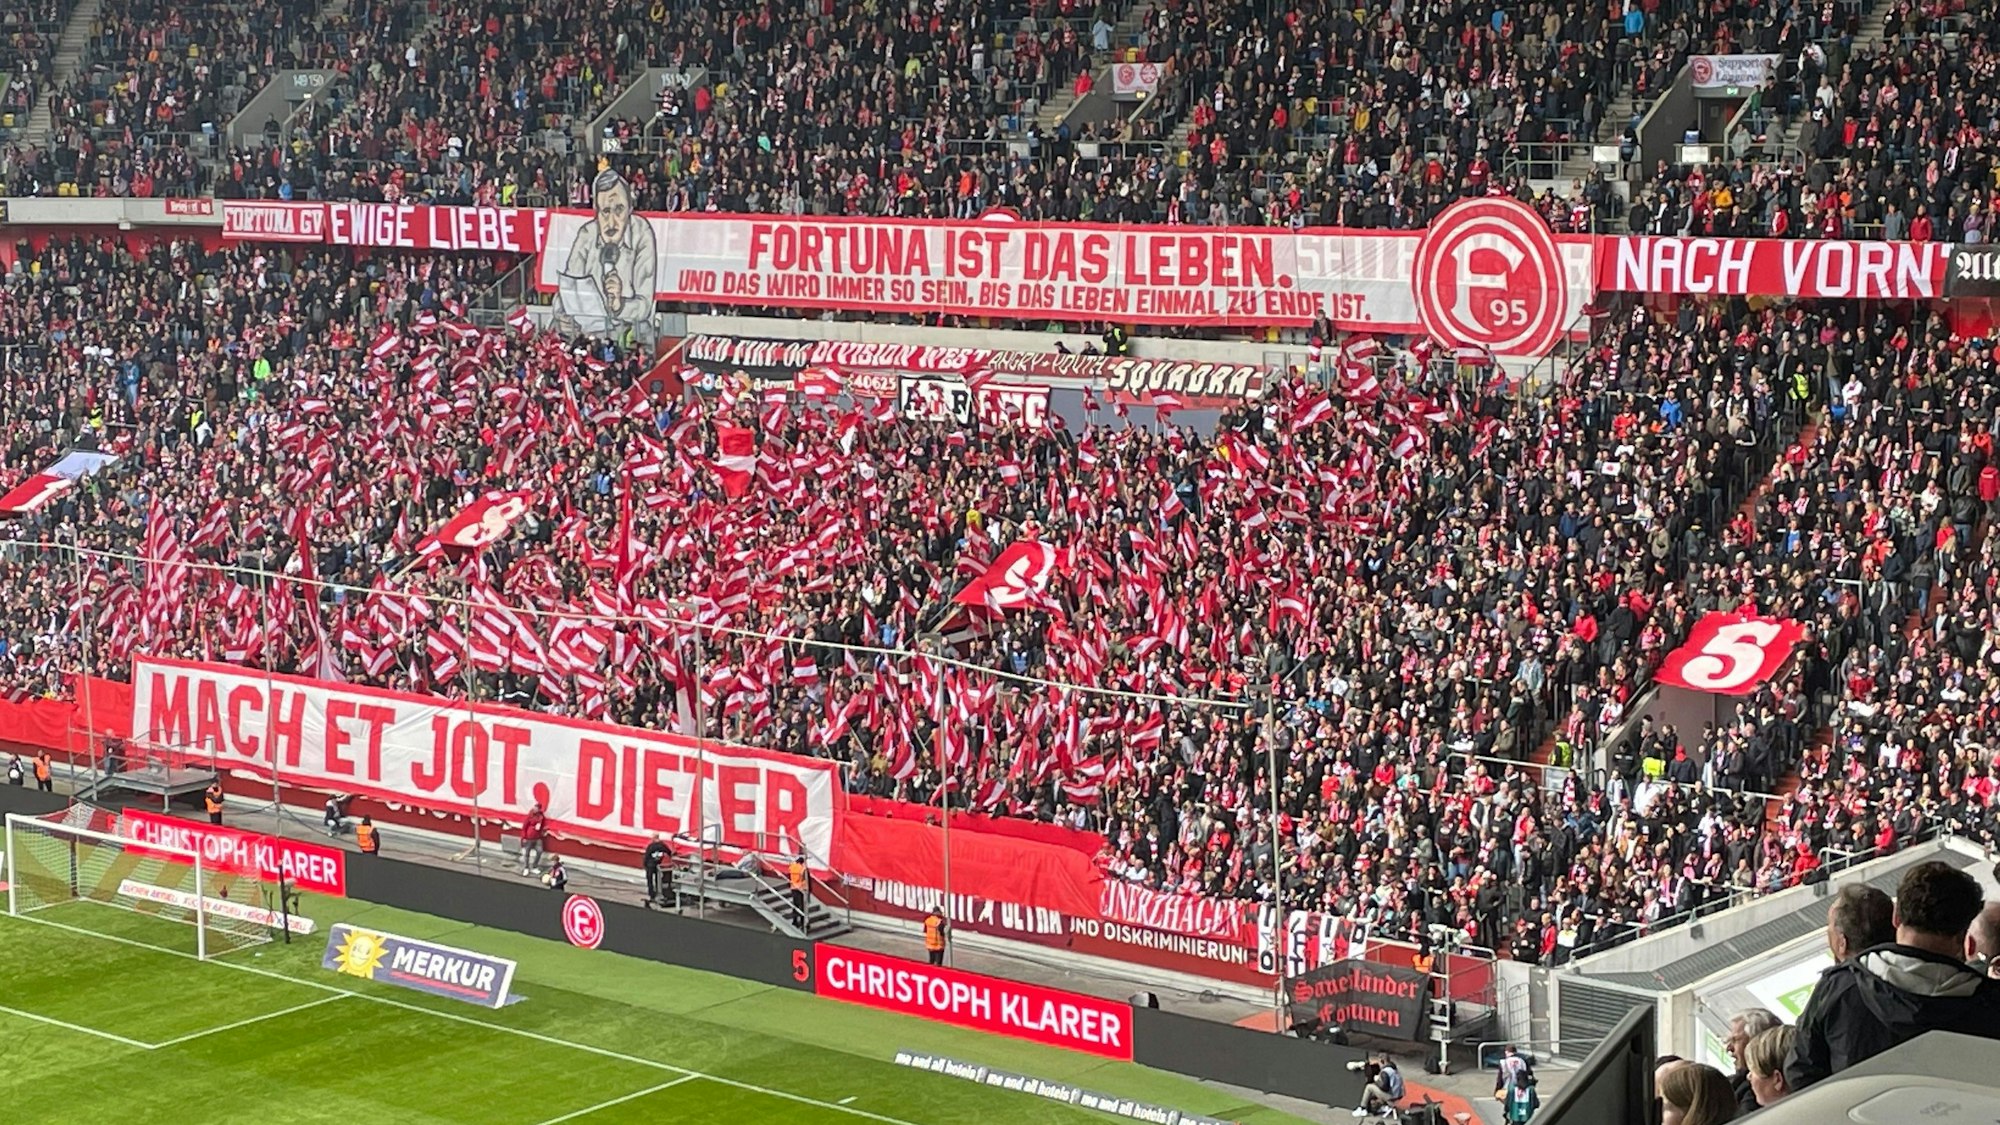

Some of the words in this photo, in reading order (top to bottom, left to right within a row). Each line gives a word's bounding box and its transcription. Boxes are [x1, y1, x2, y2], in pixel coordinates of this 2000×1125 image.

[224, 207, 296, 233] FORTUNA
[331, 204, 415, 247] EWIGE
[429, 206, 520, 252] LIEBE
[749, 224, 931, 276] FORTUNA
[945, 230, 1009, 279] IST
[1023, 231, 1110, 283] DAS
[1125, 235, 1293, 289] LEBEN.
[1616, 237, 1753, 294] NACH
[678, 269, 717, 293] UND
[722, 272, 761, 296] DAS
[767, 274, 821, 298] WIRD
[826, 275, 885, 302] IMMER
[891, 279, 915, 303] SO
[921, 280, 974, 307] SEIN,
[979, 282, 1011, 308] BIS
[1018, 284, 1056, 308] DAS
[1061, 286, 1129, 313] LEBEN
[1137, 289, 1219, 315] EINMAL
[1227, 291, 1261, 316] ZU
[1265, 292, 1324, 318] ENDE
[1333, 293, 1372, 321] IST.
[1489, 300, 1528, 326] 95
[811, 340, 913, 368] DIVISION
[918, 345, 993, 370] WEST
[1109, 360, 1255, 397] SQUADRA
[1682, 620, 1782, 689] 5
[149, 672, 306, 768] MACH
[325, 699, 396, 782] ET
[576, 738, 808, 857] DIETER
[131, 820, 248, 866] CHRISTOPH
[255, 844, 337, 886] KLARER
[391, 946, 496, 991] MERKUR
[792, 950, 810, 982] 5
[826, 957, 991, 1020] CHRISTOPH
[1002, 992, 1121, 1047] KLARER
